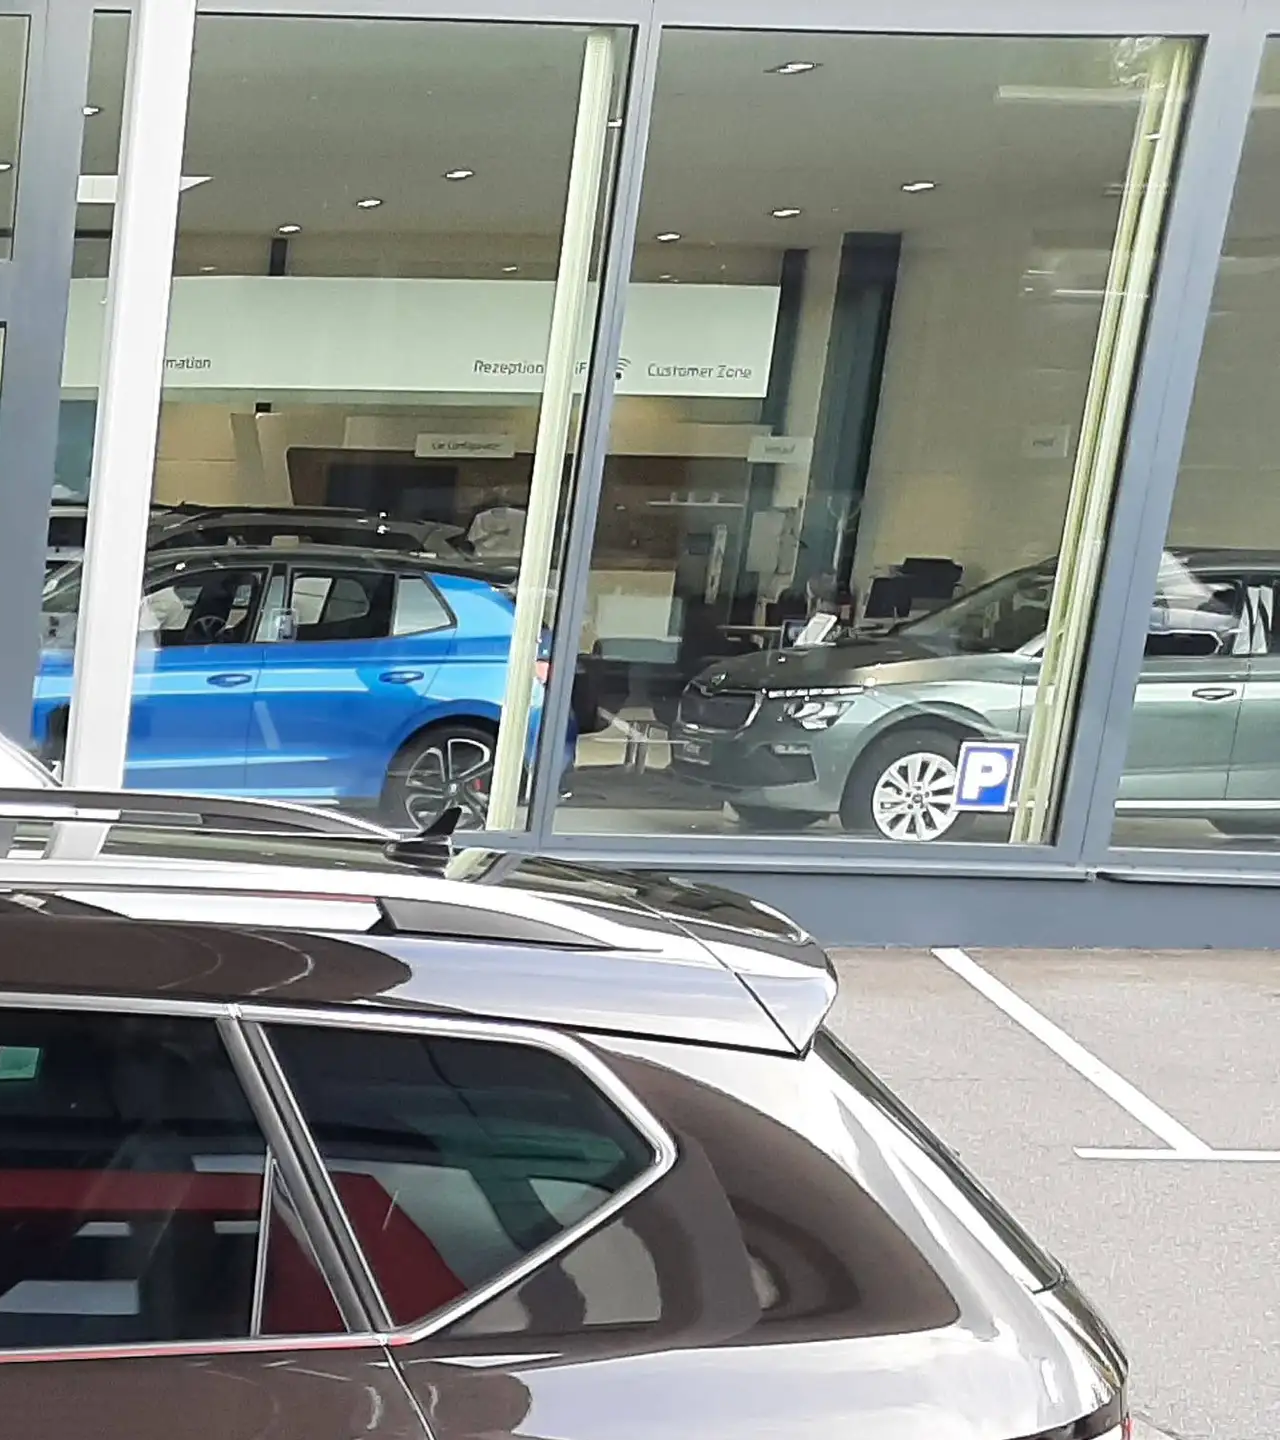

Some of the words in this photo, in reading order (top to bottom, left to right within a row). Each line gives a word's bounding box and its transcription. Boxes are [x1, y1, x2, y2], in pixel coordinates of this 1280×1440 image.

[164, 357, 211, 369] mation
[474, 360, 544, 374] Rezeption
[648, 363, 714, 377] Customer
[716, 365, 752, 379] Zone
[962, 752, 1008, 800] P
